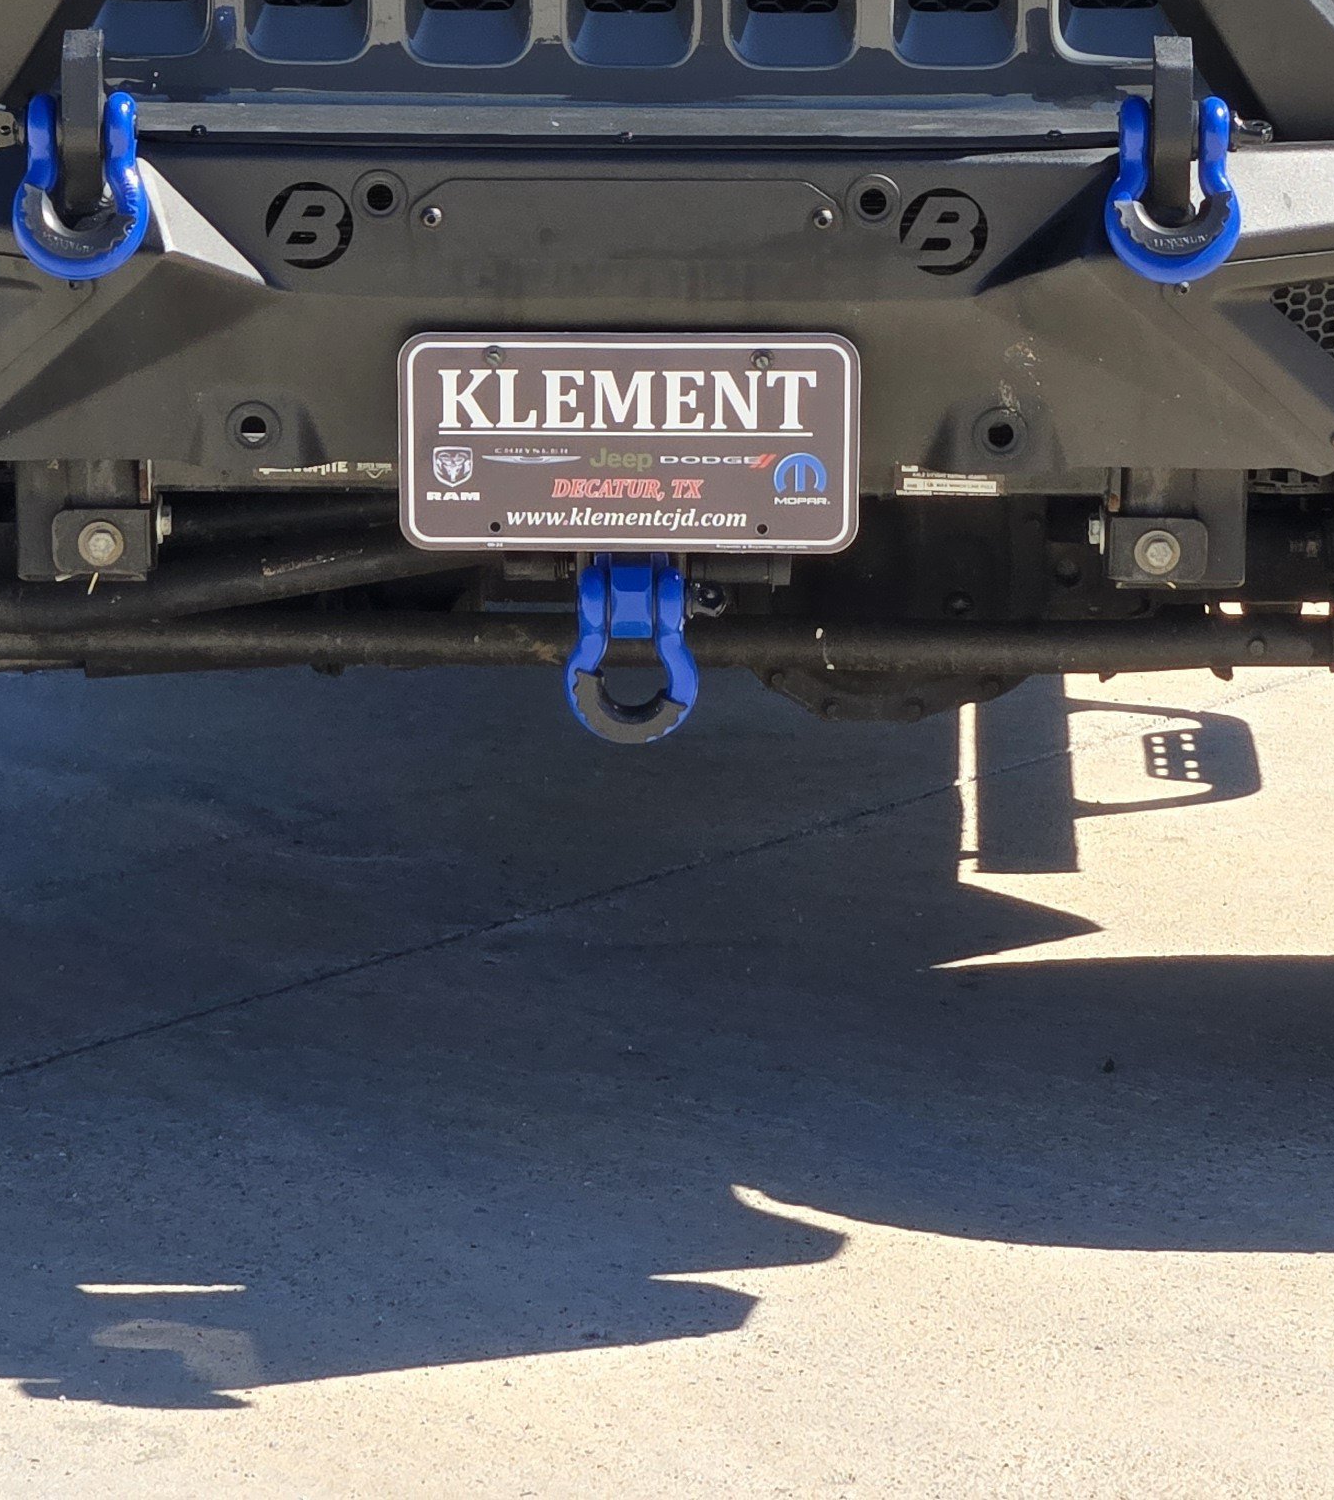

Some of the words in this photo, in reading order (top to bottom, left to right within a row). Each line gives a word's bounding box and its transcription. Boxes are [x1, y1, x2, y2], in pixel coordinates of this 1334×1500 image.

[438, 368, 817, 431] KLEMENT
[589, 447, 654, 472] Jeep
[659, 455, 760, 465] DODGE
[426, 491, 481, 501] RAM
[552, 478, 664, 502] DECATUR,
[672, 479, 706, 499] TX
[506, 506, 747, 531] www.klementcjd.com
